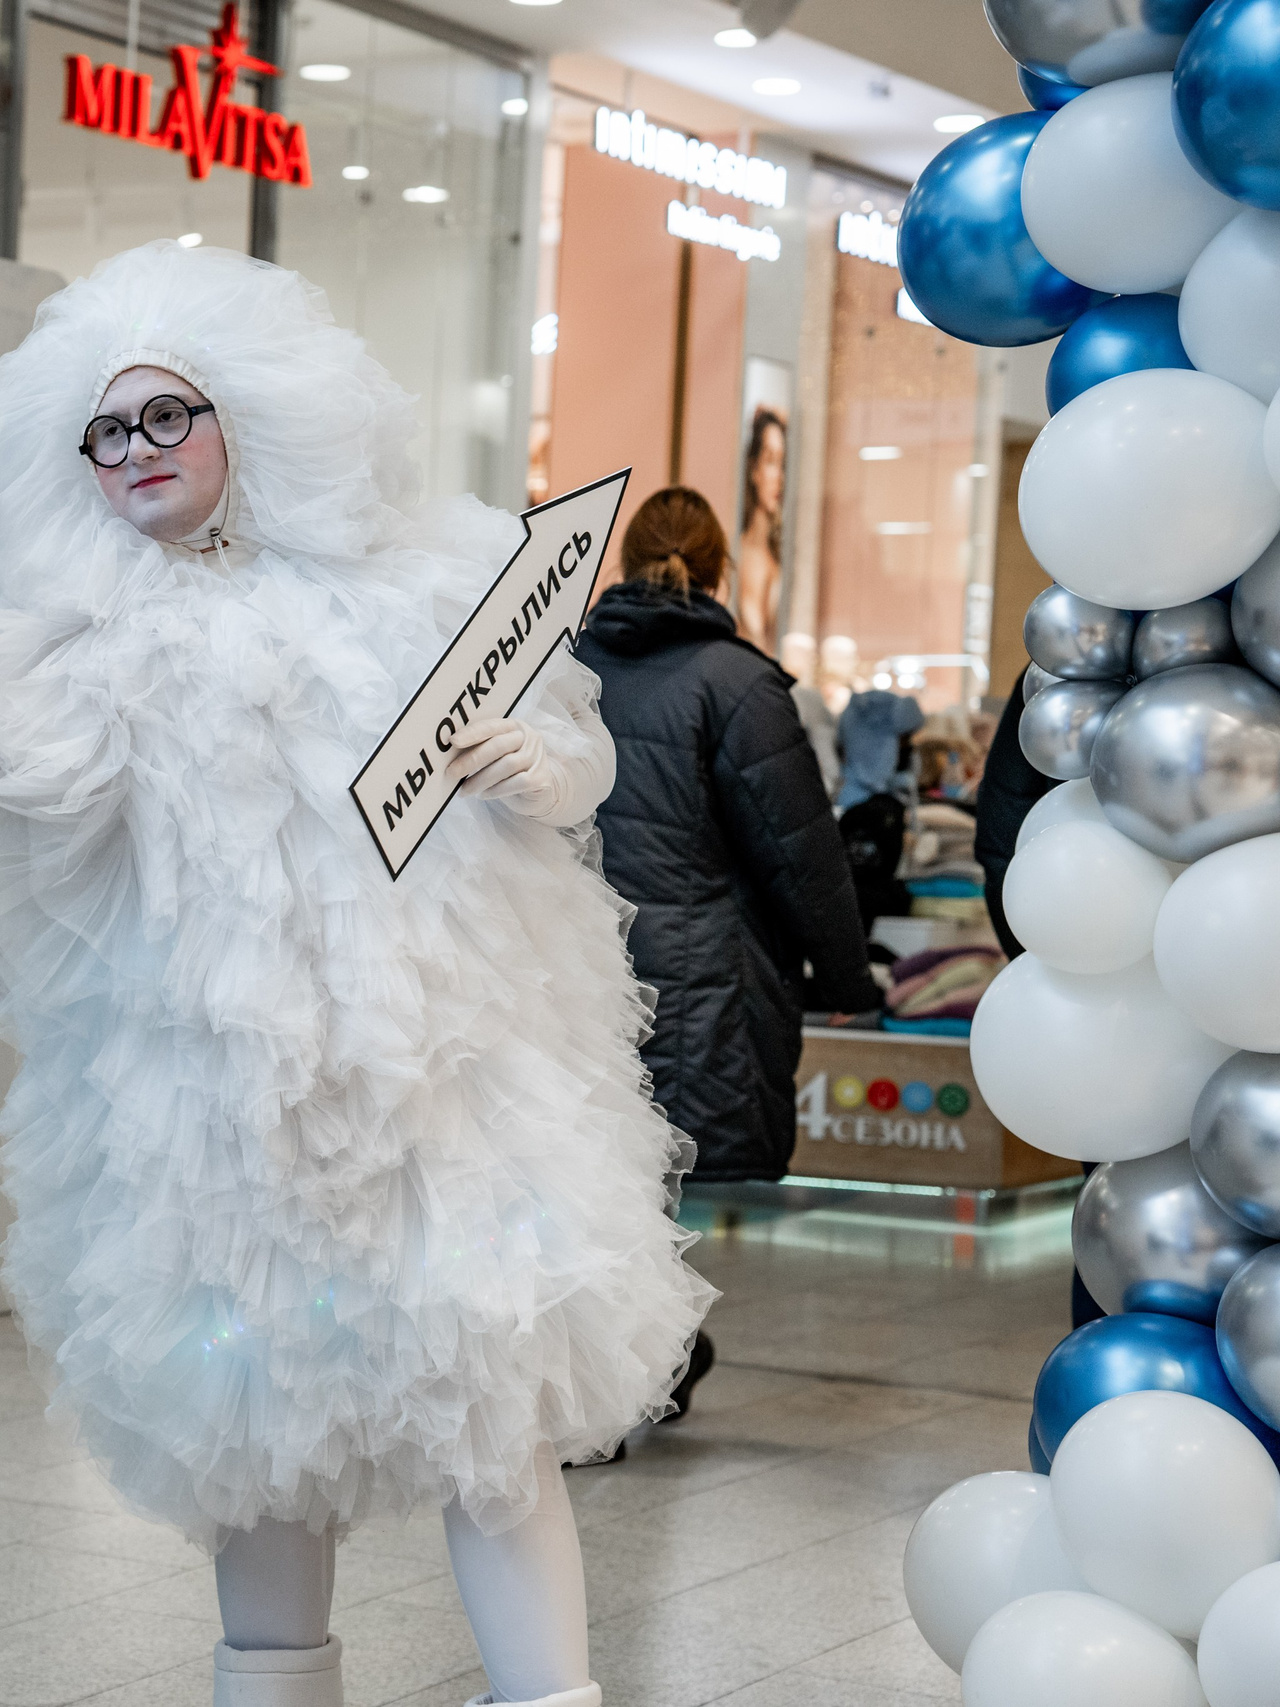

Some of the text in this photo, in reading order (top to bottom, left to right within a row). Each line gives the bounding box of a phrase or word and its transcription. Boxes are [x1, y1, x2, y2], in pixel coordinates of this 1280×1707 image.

[63, 43, 313, 189] MILAVITSA
[380, 530, 594, 832] МЫ ОТКРЫЛИСЬ
[795, 1071, 967, 1152] 4 СЕЗОНА
